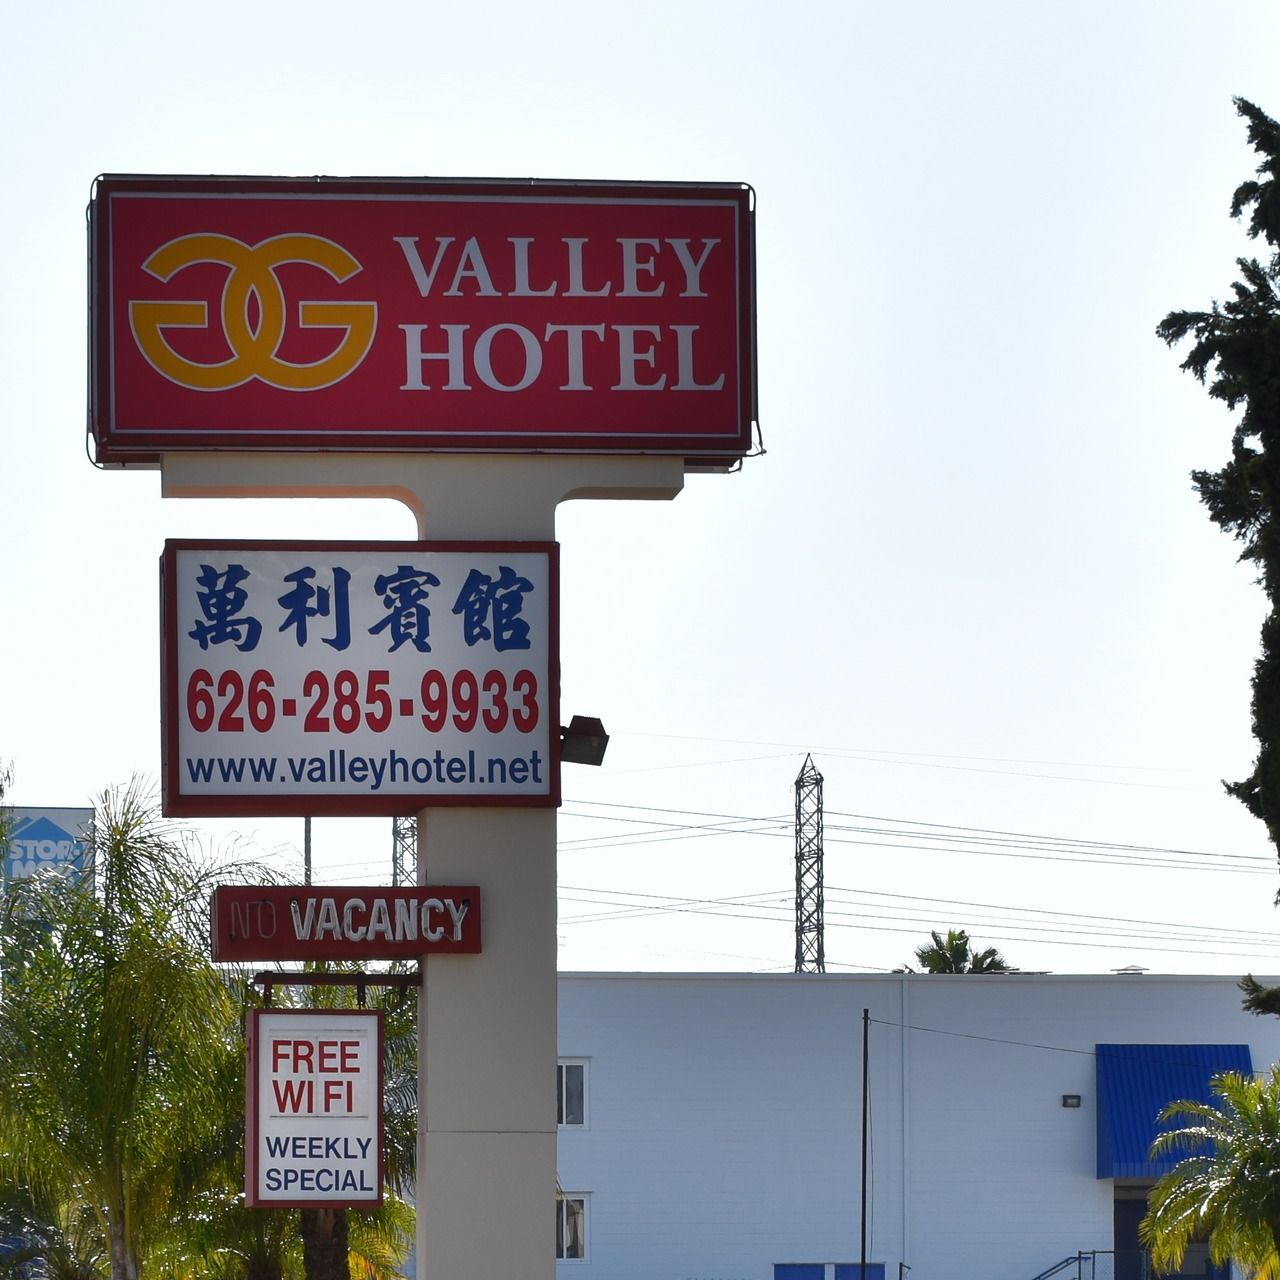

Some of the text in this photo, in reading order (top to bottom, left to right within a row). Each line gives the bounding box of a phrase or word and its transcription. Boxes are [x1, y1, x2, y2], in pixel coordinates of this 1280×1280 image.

[393, 236, 721, 299] VALLEY
[398, 323, 726, 392] HOTEL
[187, 564, 534, 653] 萬利賓館
[186, 749, 543, 790] www.valleyhotel.net
[230, 898, 469, 942] NO VACANCY
[272, 1040, 360, 1073] FREE
[265, 1137, 373, 1159] WEEKLY
[265, 1168, 374, 1191] SPECIAL
